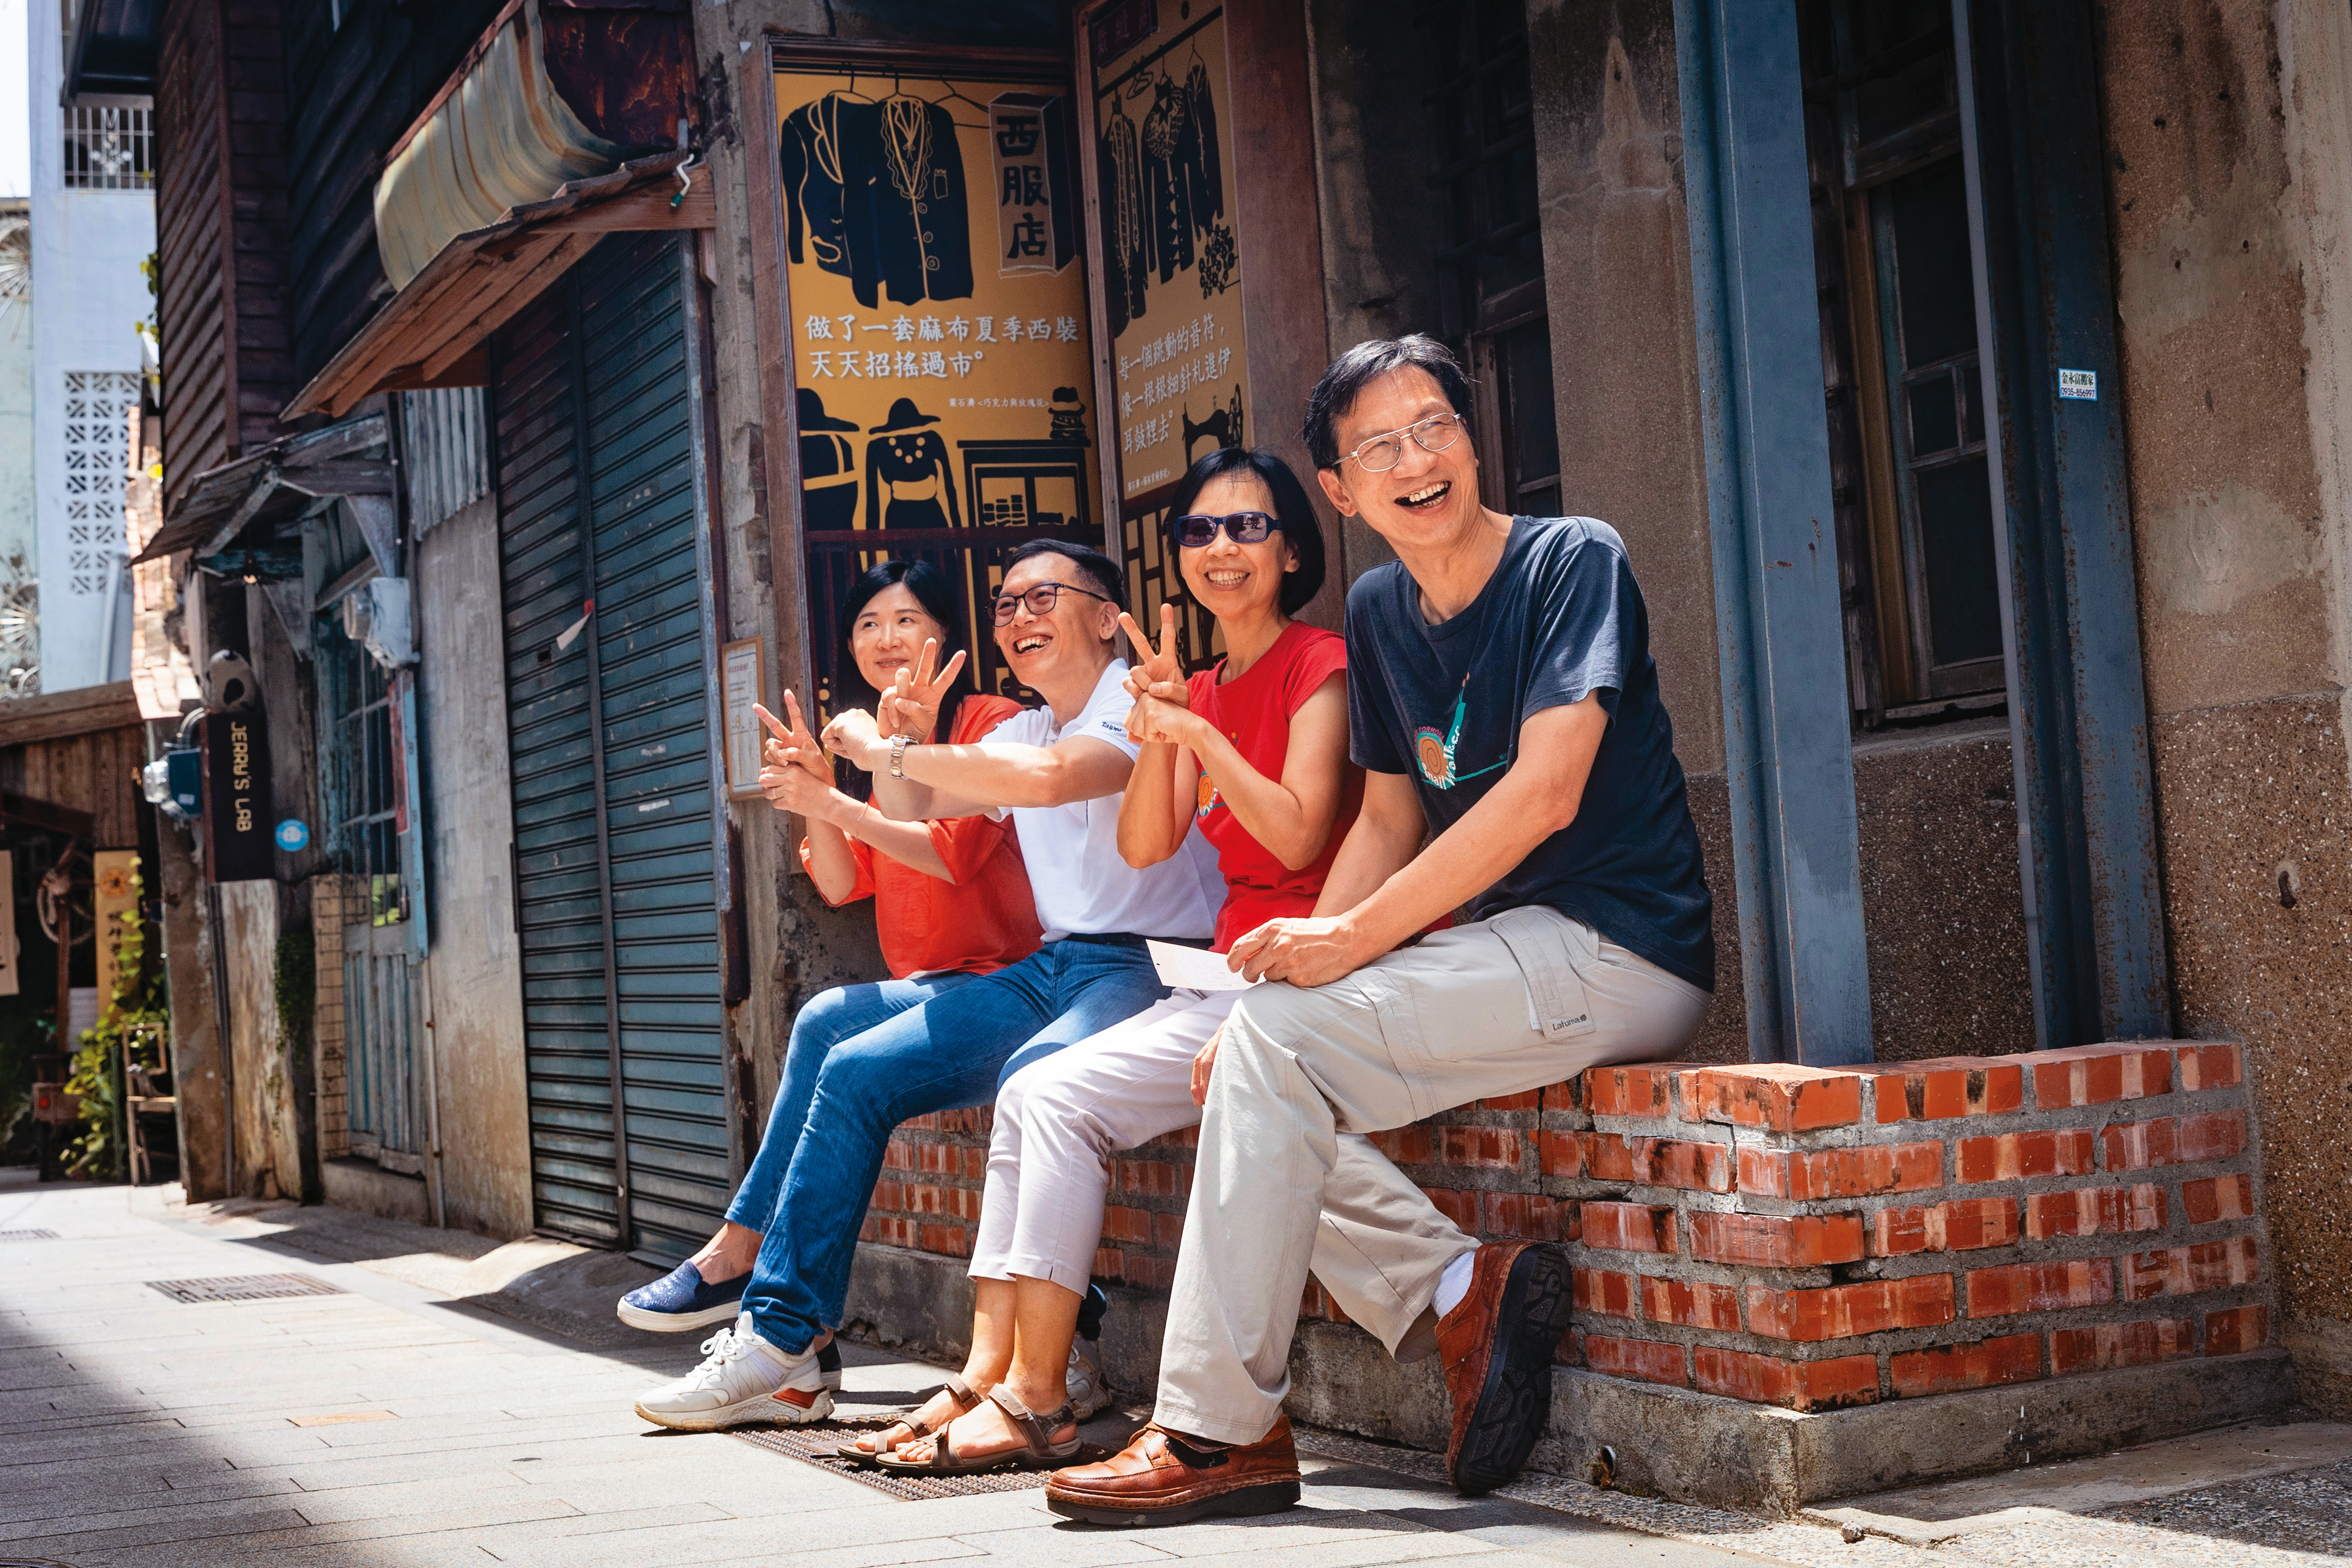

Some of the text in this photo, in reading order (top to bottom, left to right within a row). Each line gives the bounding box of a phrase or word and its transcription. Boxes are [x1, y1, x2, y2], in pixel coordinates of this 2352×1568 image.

[996, 116, 1049, 258] 西服店
[805, 314, 1078, 343] 做了一套麻布夏季西裝
[2061, 387, 2095, 397] 0935-856997
[231, 721, 252, 832] JERRY'S LAB
[1552, 1017, 1580, 1031] Lafuma
